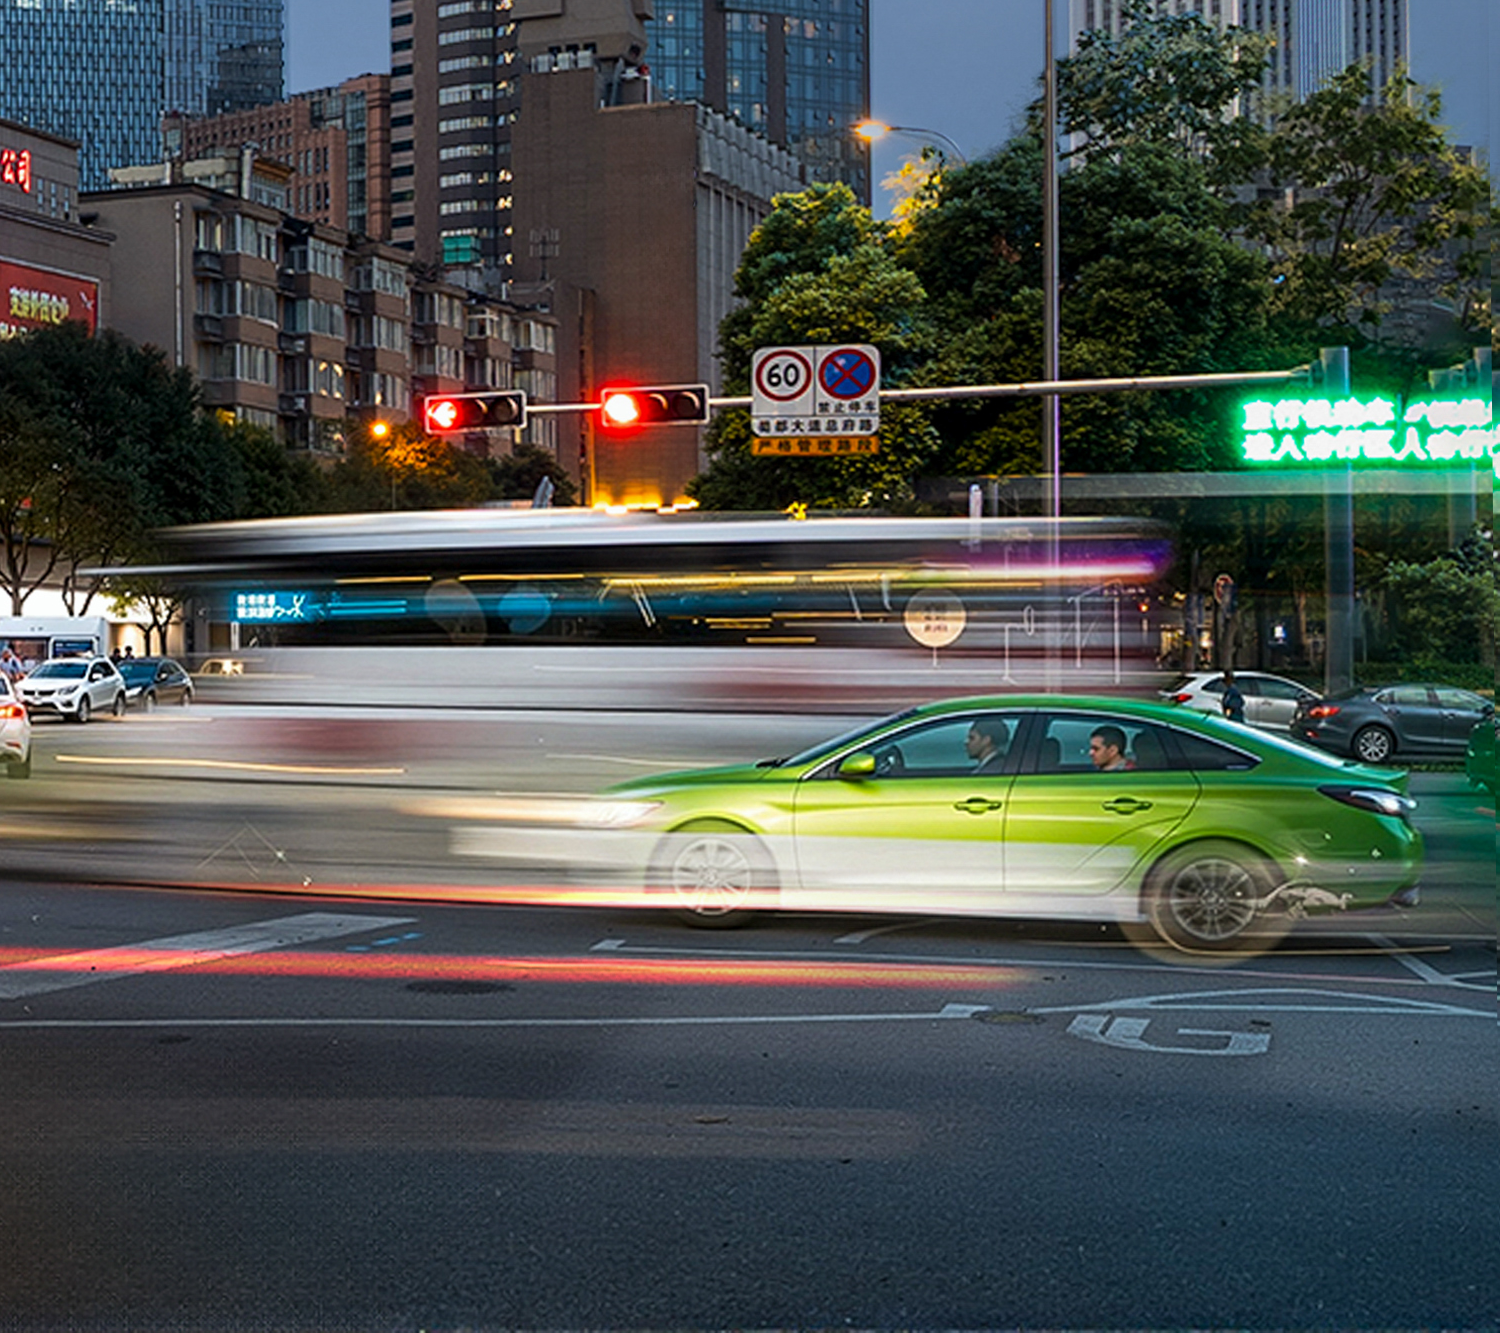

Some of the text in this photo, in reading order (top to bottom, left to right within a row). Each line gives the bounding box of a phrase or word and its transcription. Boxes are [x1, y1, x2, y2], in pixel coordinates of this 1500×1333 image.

[767, 363, 799, 387] 60
[818, 400, 876, 413] 禁止停车
[759, 439, 872, 452] 严格管理路段
